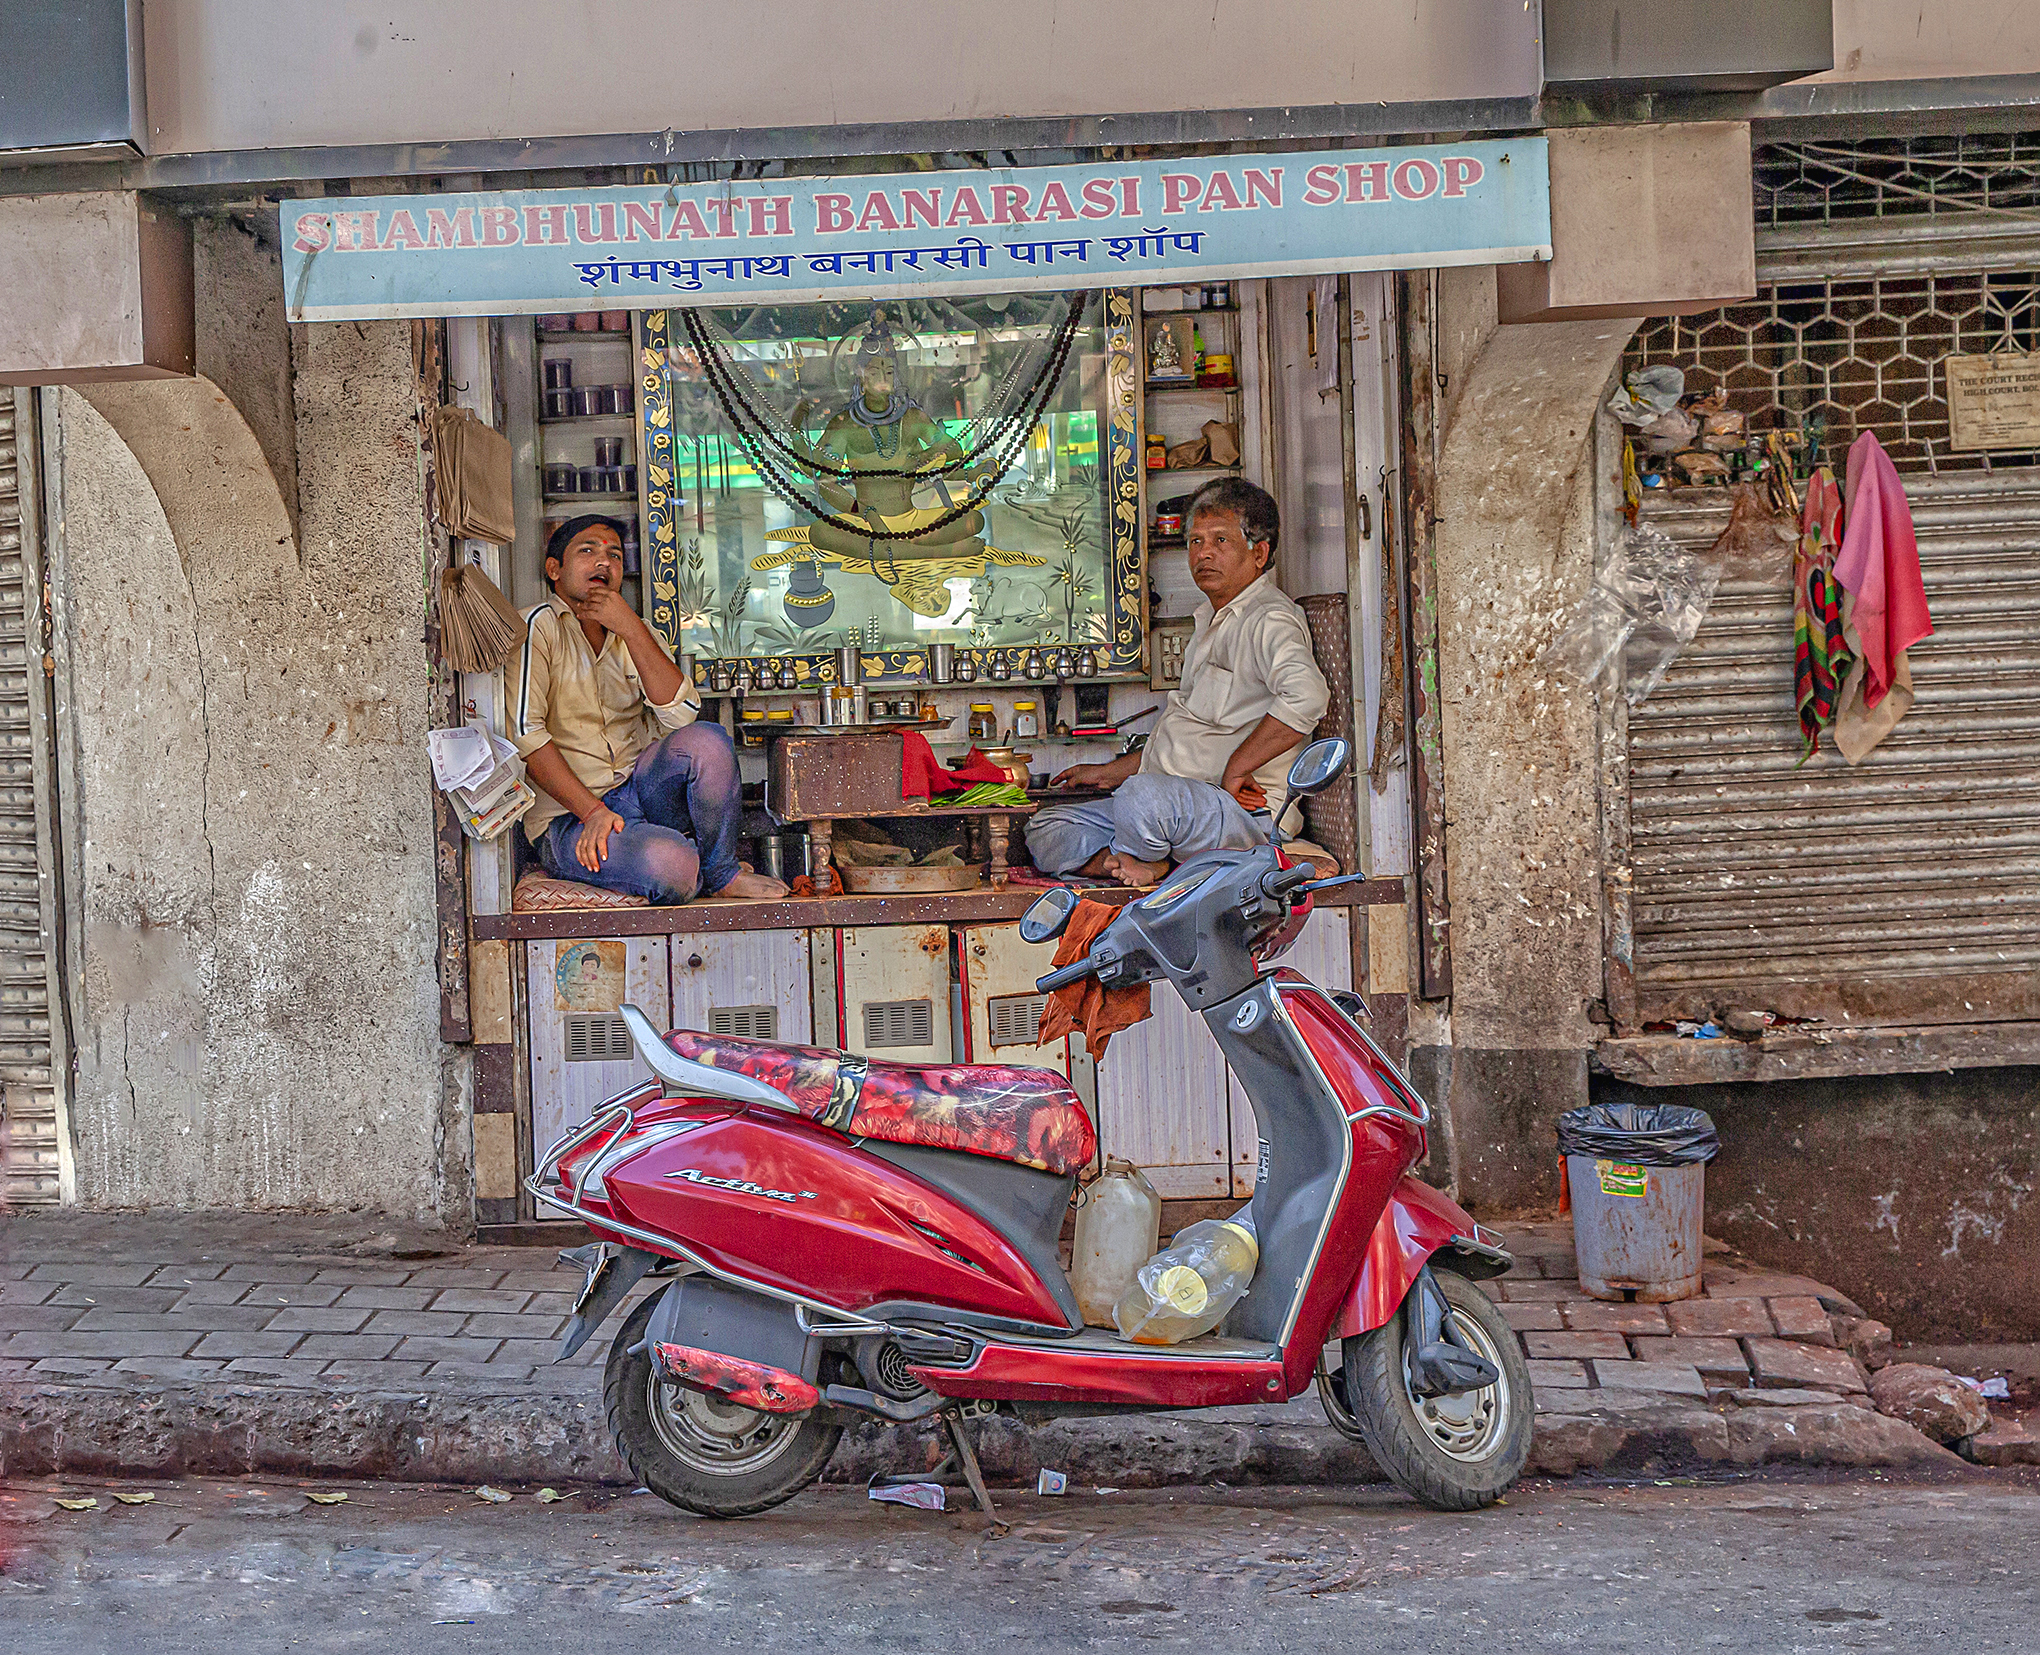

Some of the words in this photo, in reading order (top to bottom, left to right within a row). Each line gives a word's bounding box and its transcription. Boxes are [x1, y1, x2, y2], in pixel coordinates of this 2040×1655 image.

[294, 195, 794, 253] SHAMBHUNATH
[814, 175, 1142, 235] BANARASI
[1161, 166, 1287, 215] PAN
[1301, 156, 1485, 206] SHOP
[802, 237, 994, 276] बनारसी
[1003, 237, 1094, 265] पान
[1100, 226, 1208, 264] शॉप
[1963, 388, 1987, 397] HIGH
[1980, 376, 2012, 385] COURT
